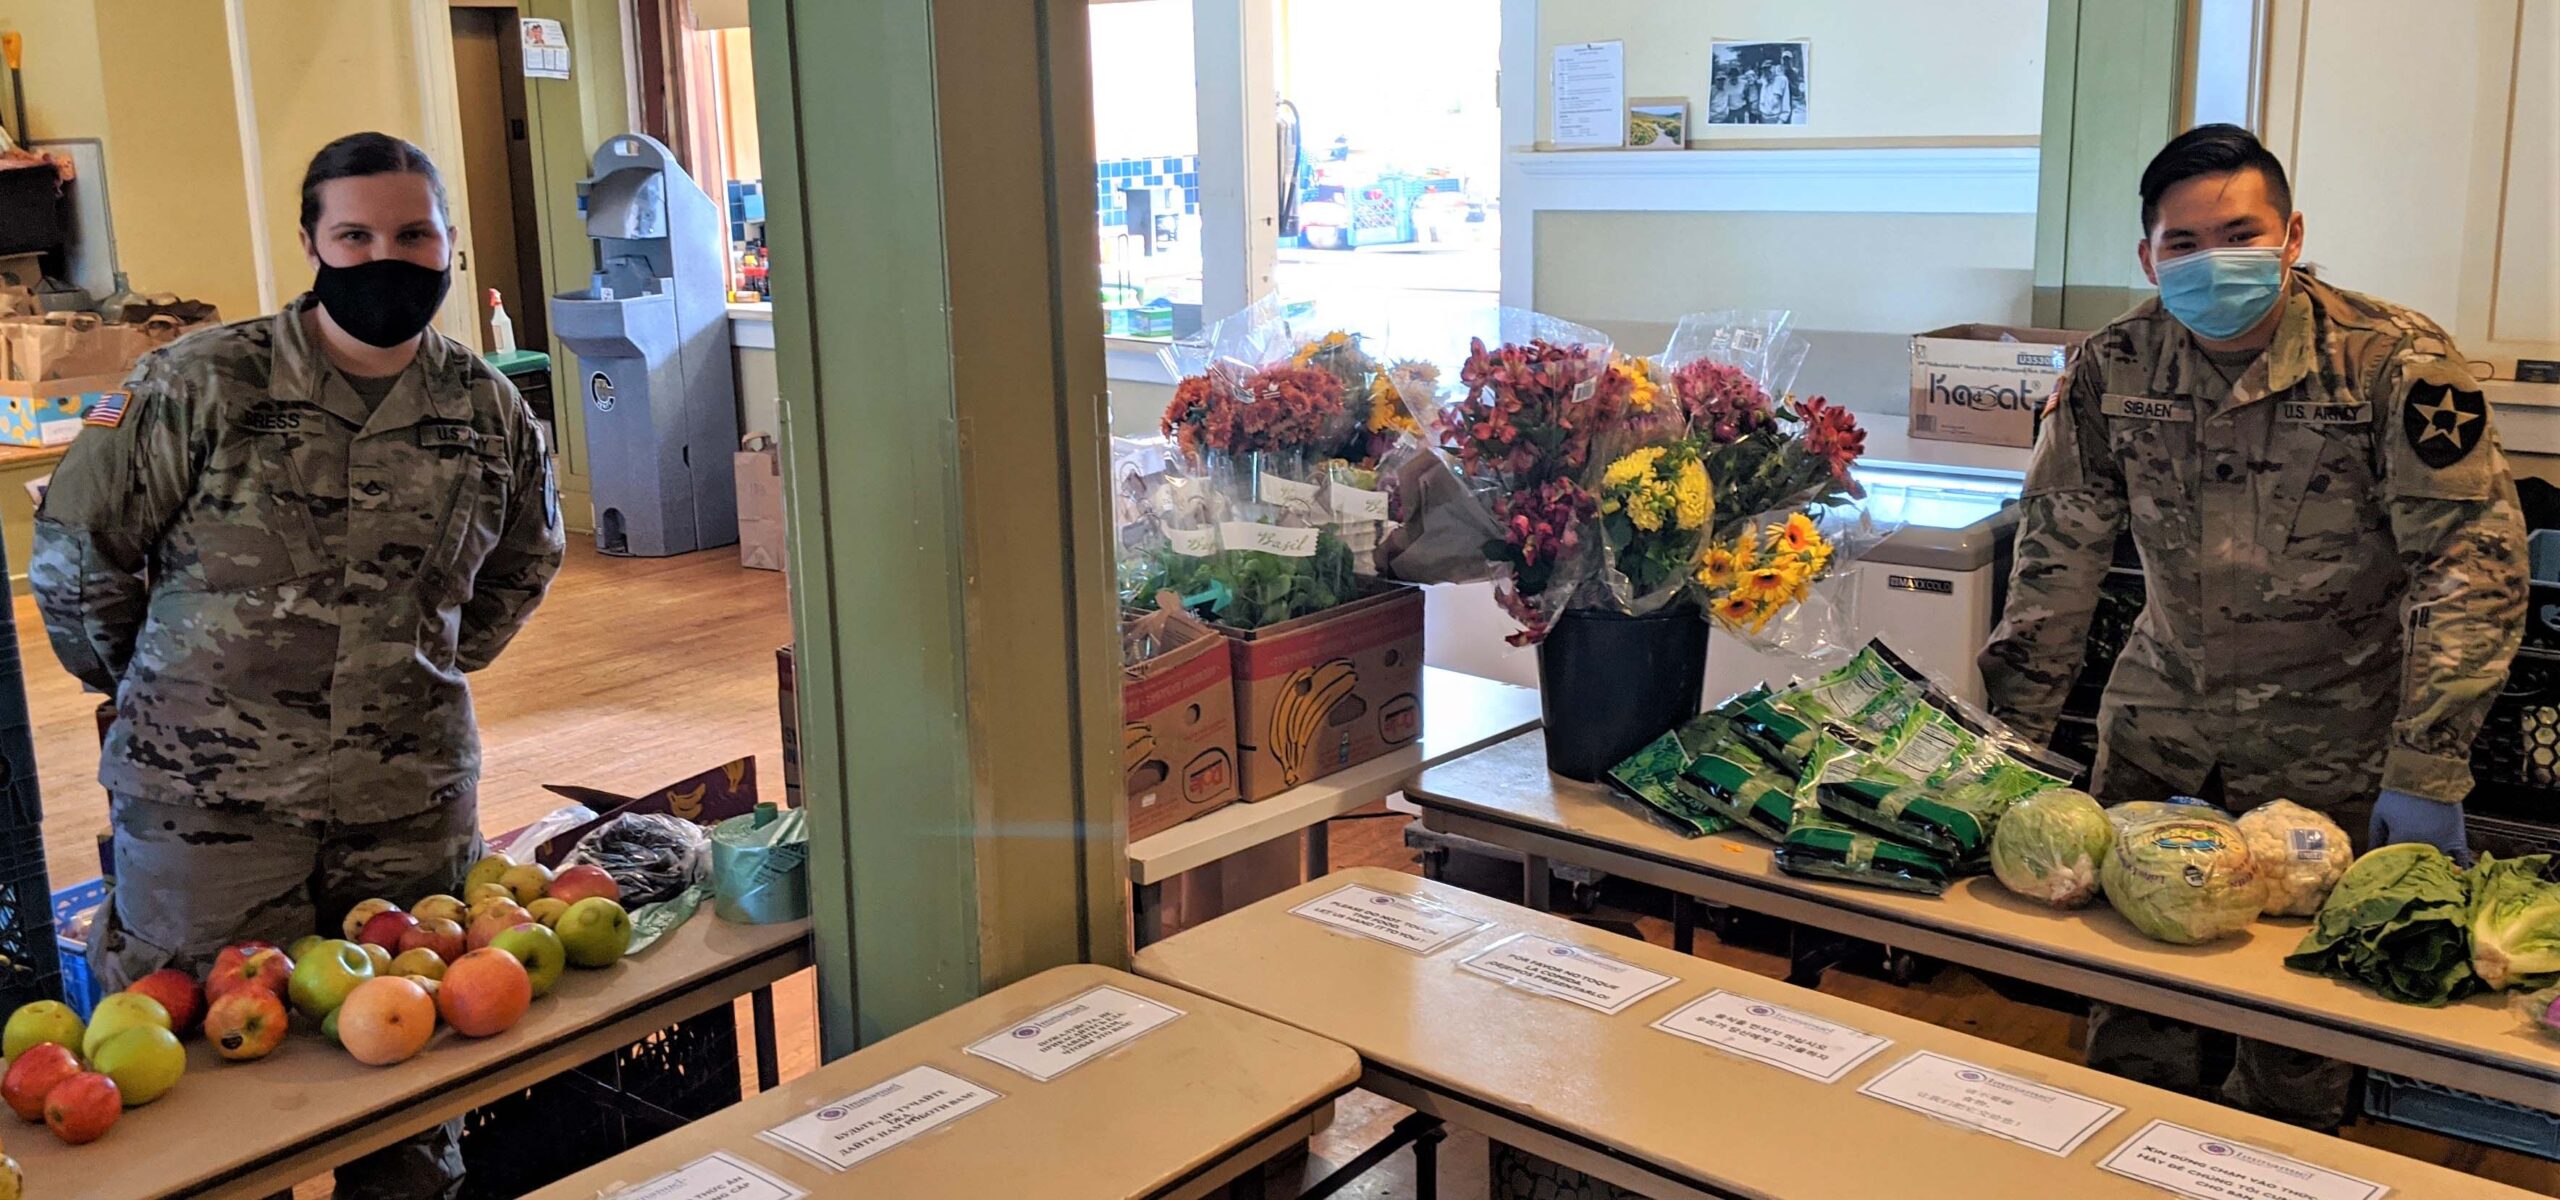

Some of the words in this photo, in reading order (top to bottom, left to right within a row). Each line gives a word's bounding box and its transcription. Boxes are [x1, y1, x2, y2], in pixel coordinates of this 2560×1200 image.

[2124, 400, 2172, 418] SIBAEN
[2313, 404, 2360, 420] ARMY
[1257, 530, 1309, 551] Basil
[1346, 916, 1374, 926] HAND
[1404, 922, 1438, 935] TOUCH
[1509, 954, 1530, 962] POR
[1530, 960, 1563, 972] FAVOR
[1582, 976, 1619, 989] TOQUE
[2144, 1146, 2167, 1155] XIN
[2195, 1181, 2224, 1191] CHO
